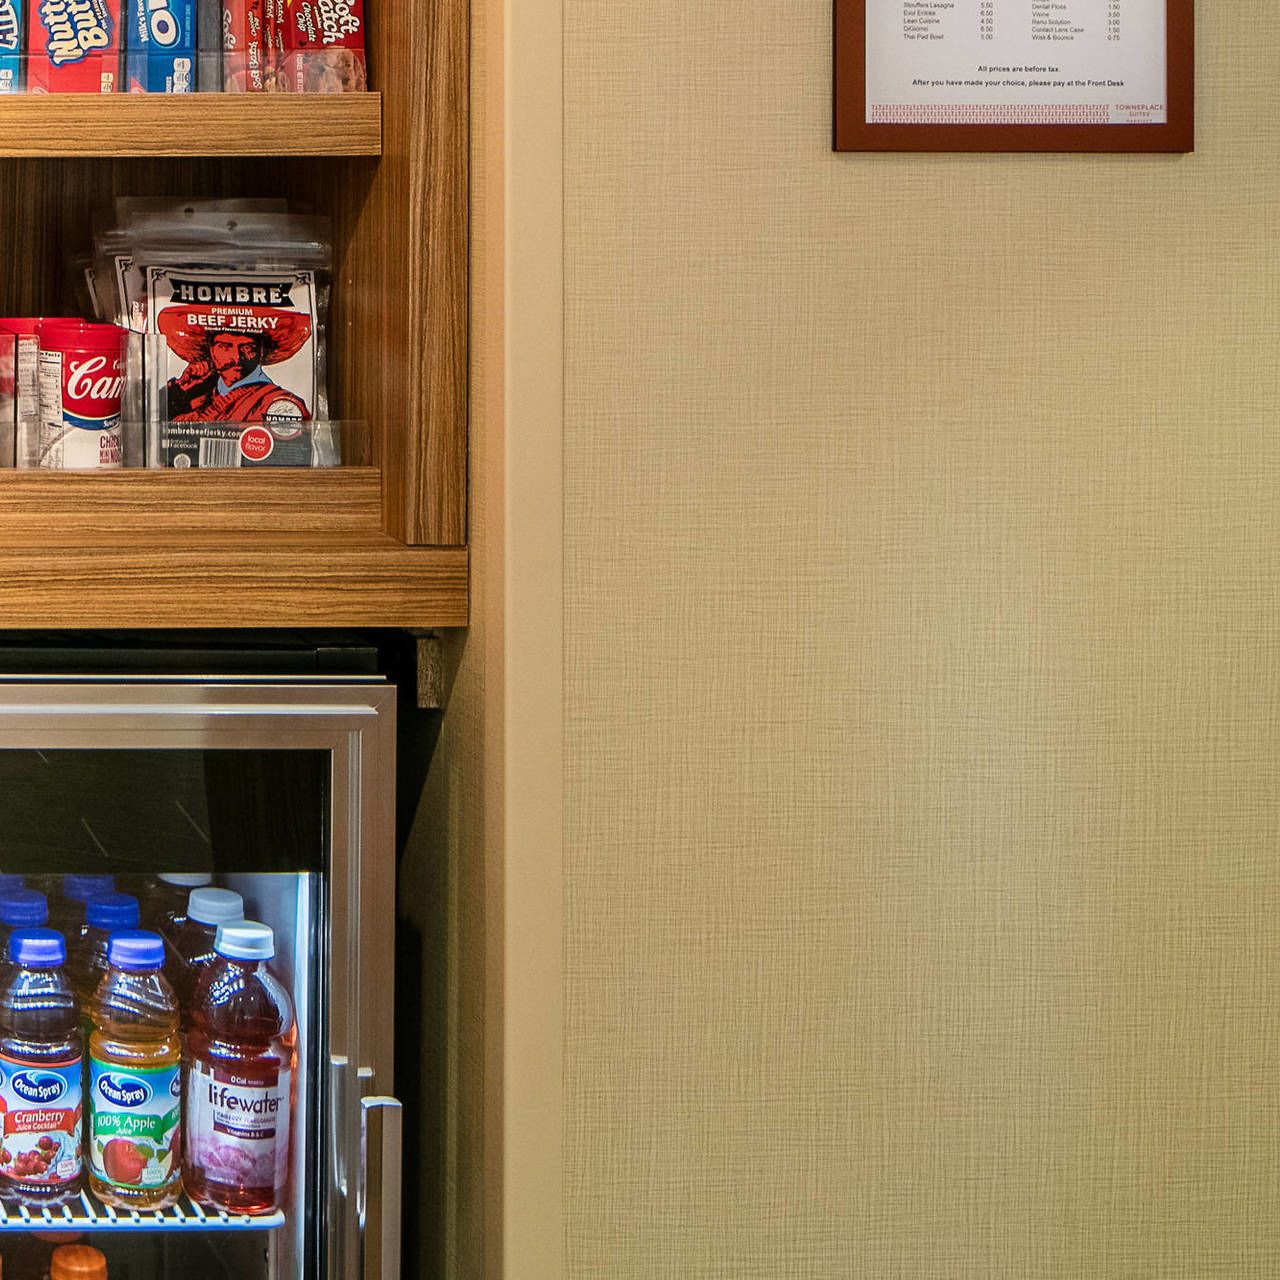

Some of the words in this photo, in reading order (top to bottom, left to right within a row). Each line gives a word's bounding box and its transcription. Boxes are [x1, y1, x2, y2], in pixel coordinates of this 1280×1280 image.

[988, 65, 1010, 73] prices
[1001, 79, 1027, 87] choice,
[1028, 79, 1051, 87] please
[1052, 80, 1065, 88] pay
[1087, 79, 1106, 87] Front
[1107, 79, 1124, 87] Desk
[179, 282, 284, 305] HOMBRE
[211, 306, 254, 317] PREMIUM
[186, 313, 228, 328] BEEF
[230, 314, 279, 330] JERKY
[247, 434, 266, 444] local
[13, 1079, 39, 1097] Ocean
[38, 1081, 63, 1100] Spray
[99, 1079, 122, 1099] Ocean
[121, 1086, 145, 1104] Spray
[208, 1082, 281, 1115] lifewater
[13, 1111, 66, 1126] Cranberry
[96, 1114, 121, 1128] 100%
[123, 1115, 156, 1132] Apple
[114, 1126, 133, 1135] Juice
